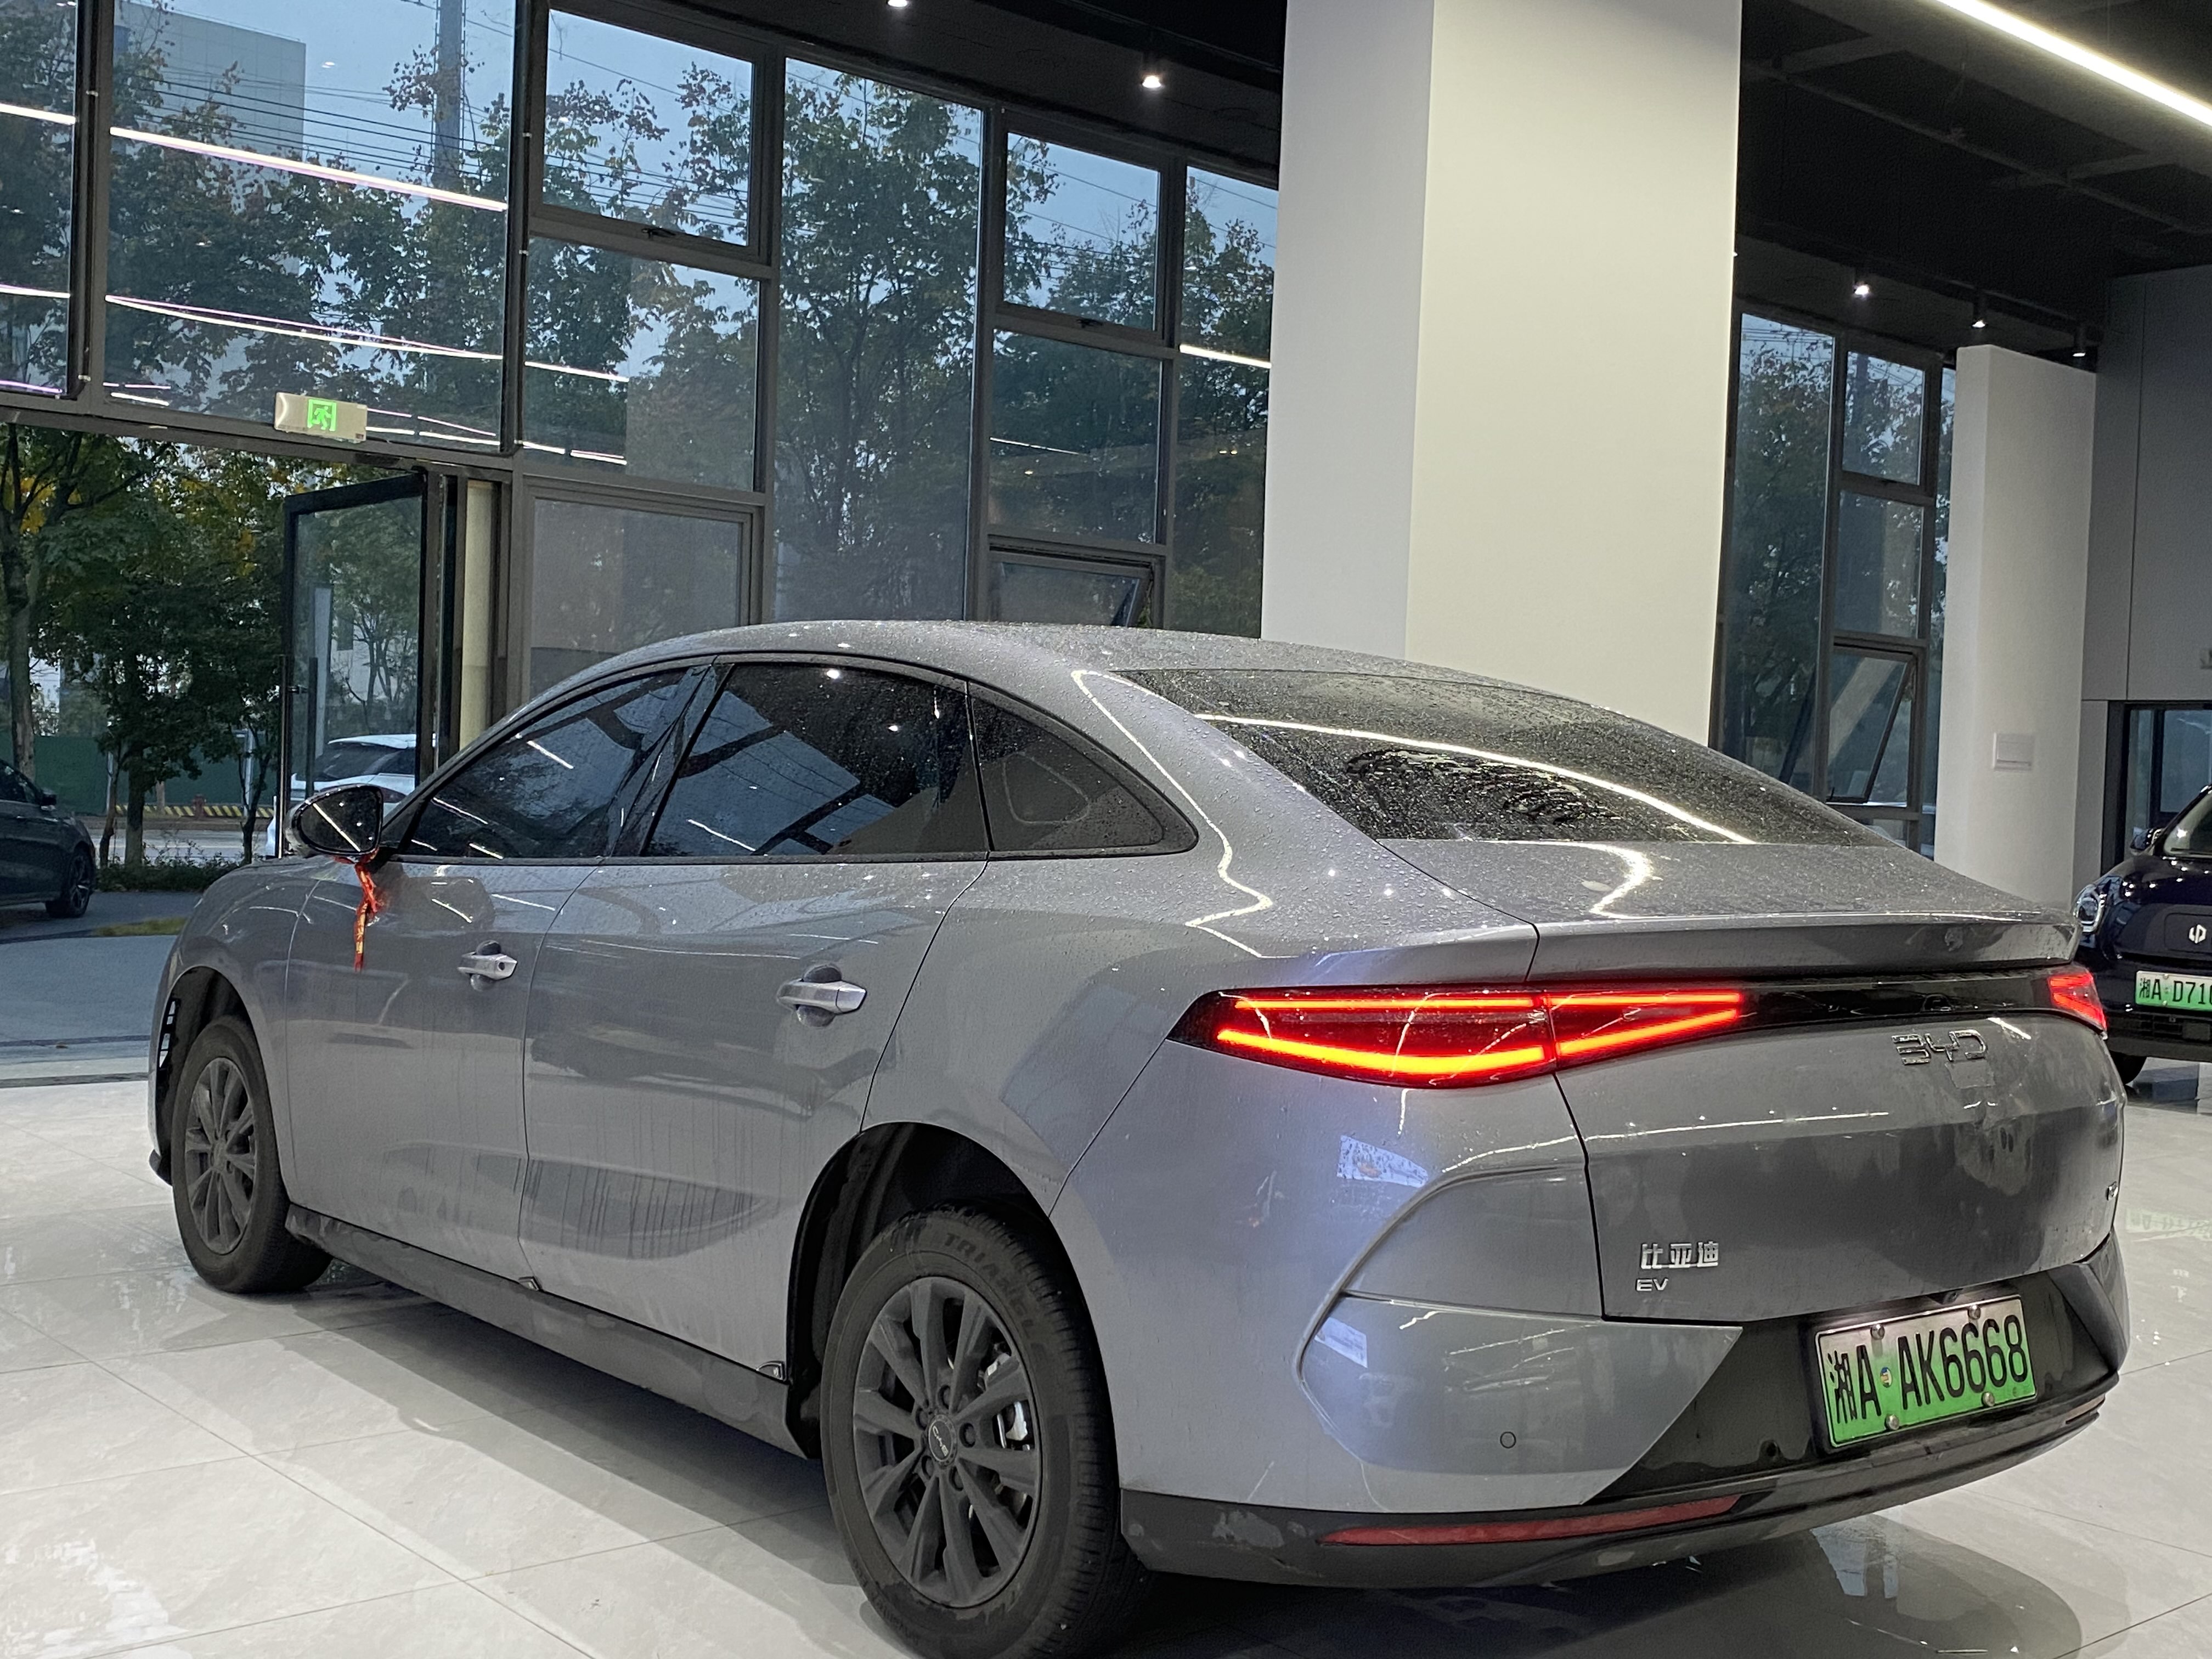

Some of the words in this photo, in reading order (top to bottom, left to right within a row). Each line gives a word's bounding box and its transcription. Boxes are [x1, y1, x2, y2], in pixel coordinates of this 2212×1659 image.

[2172, 980, 2212, 1006] D71
[1892, 1029, 1987, 1065] BYD
[1641, 1241, 1718, 1269] 比亚迪
[1636, 1278, 1668, 1291] EV
[1897, 1314, 2028, 1410] AK6668
